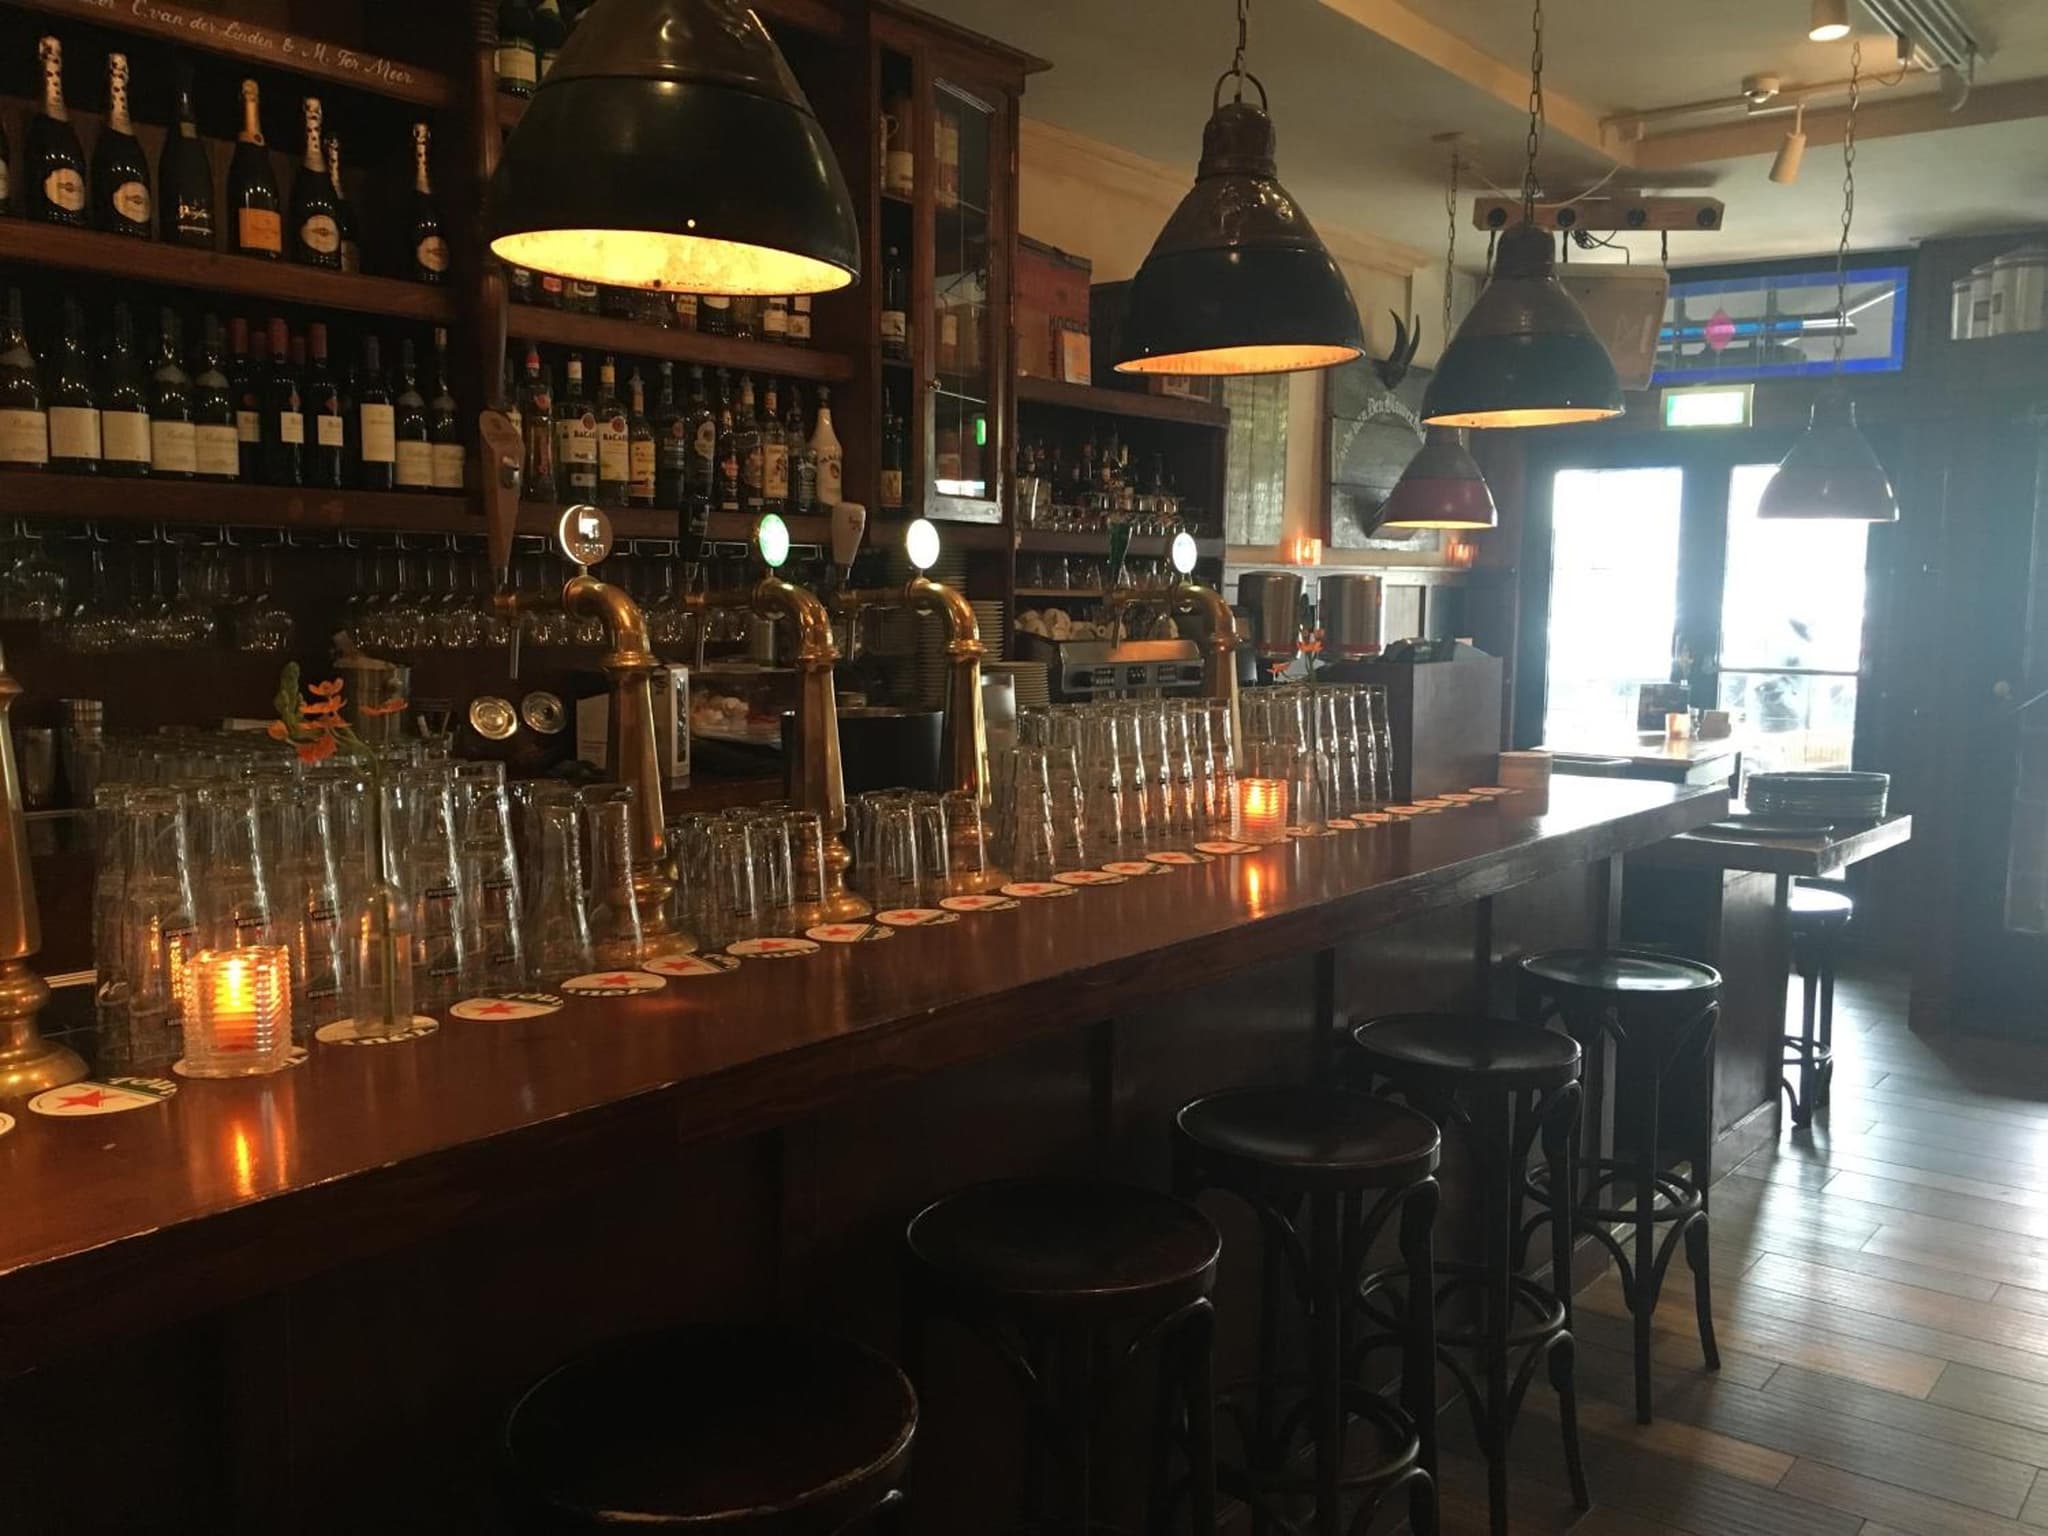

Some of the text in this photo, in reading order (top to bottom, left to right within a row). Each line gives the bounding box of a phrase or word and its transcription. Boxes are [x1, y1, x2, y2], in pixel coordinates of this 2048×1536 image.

[190, 17, 215, 33] der
[224, 21, 273, 48] Linden
[283, 38, 295, 52] &
[364, 57, 415, 84] Meer
